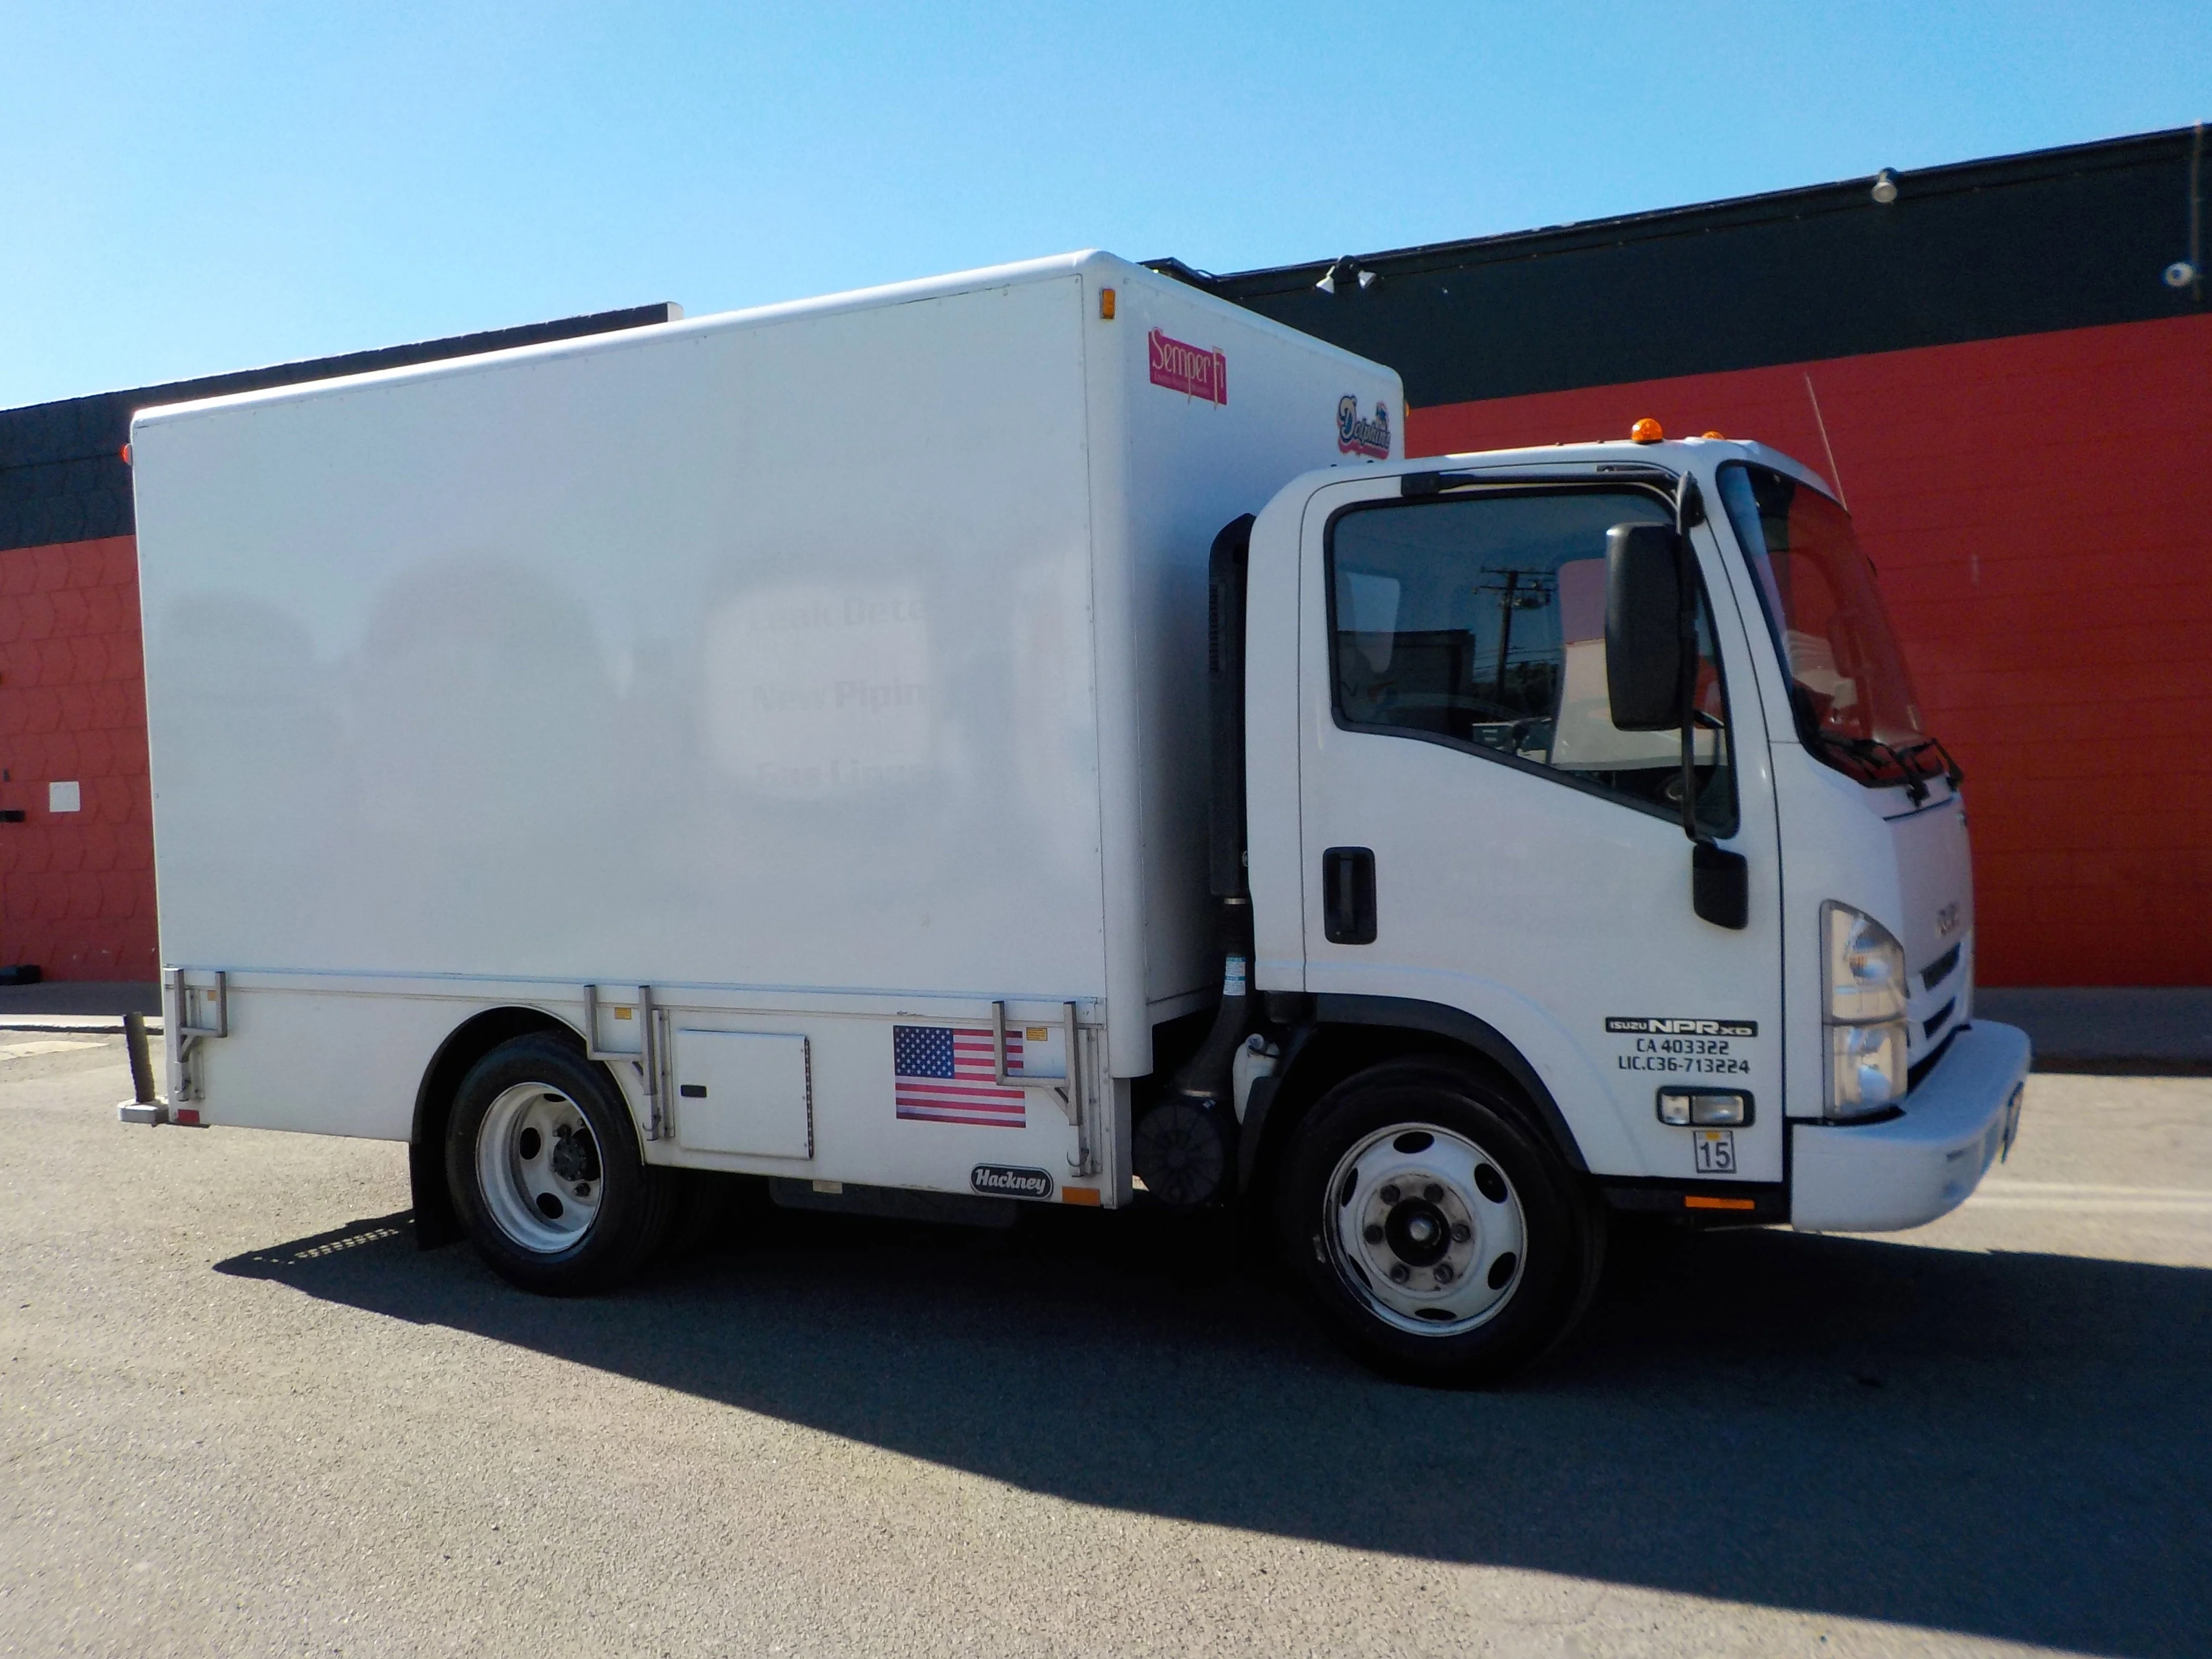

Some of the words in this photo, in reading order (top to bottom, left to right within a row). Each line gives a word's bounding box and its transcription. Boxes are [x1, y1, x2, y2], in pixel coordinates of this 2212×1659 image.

[1152, 326, 1211, 405] Semper
[1609, 1020, 1647, 1030] ISUZU
[1637, 1038, 1657, 1053] CA
[1661, 1039, 1729, 1055] 403322
[1700, 1141, 1731, 1169] 15
[975, 1168, 1046, 1195] Hackney
